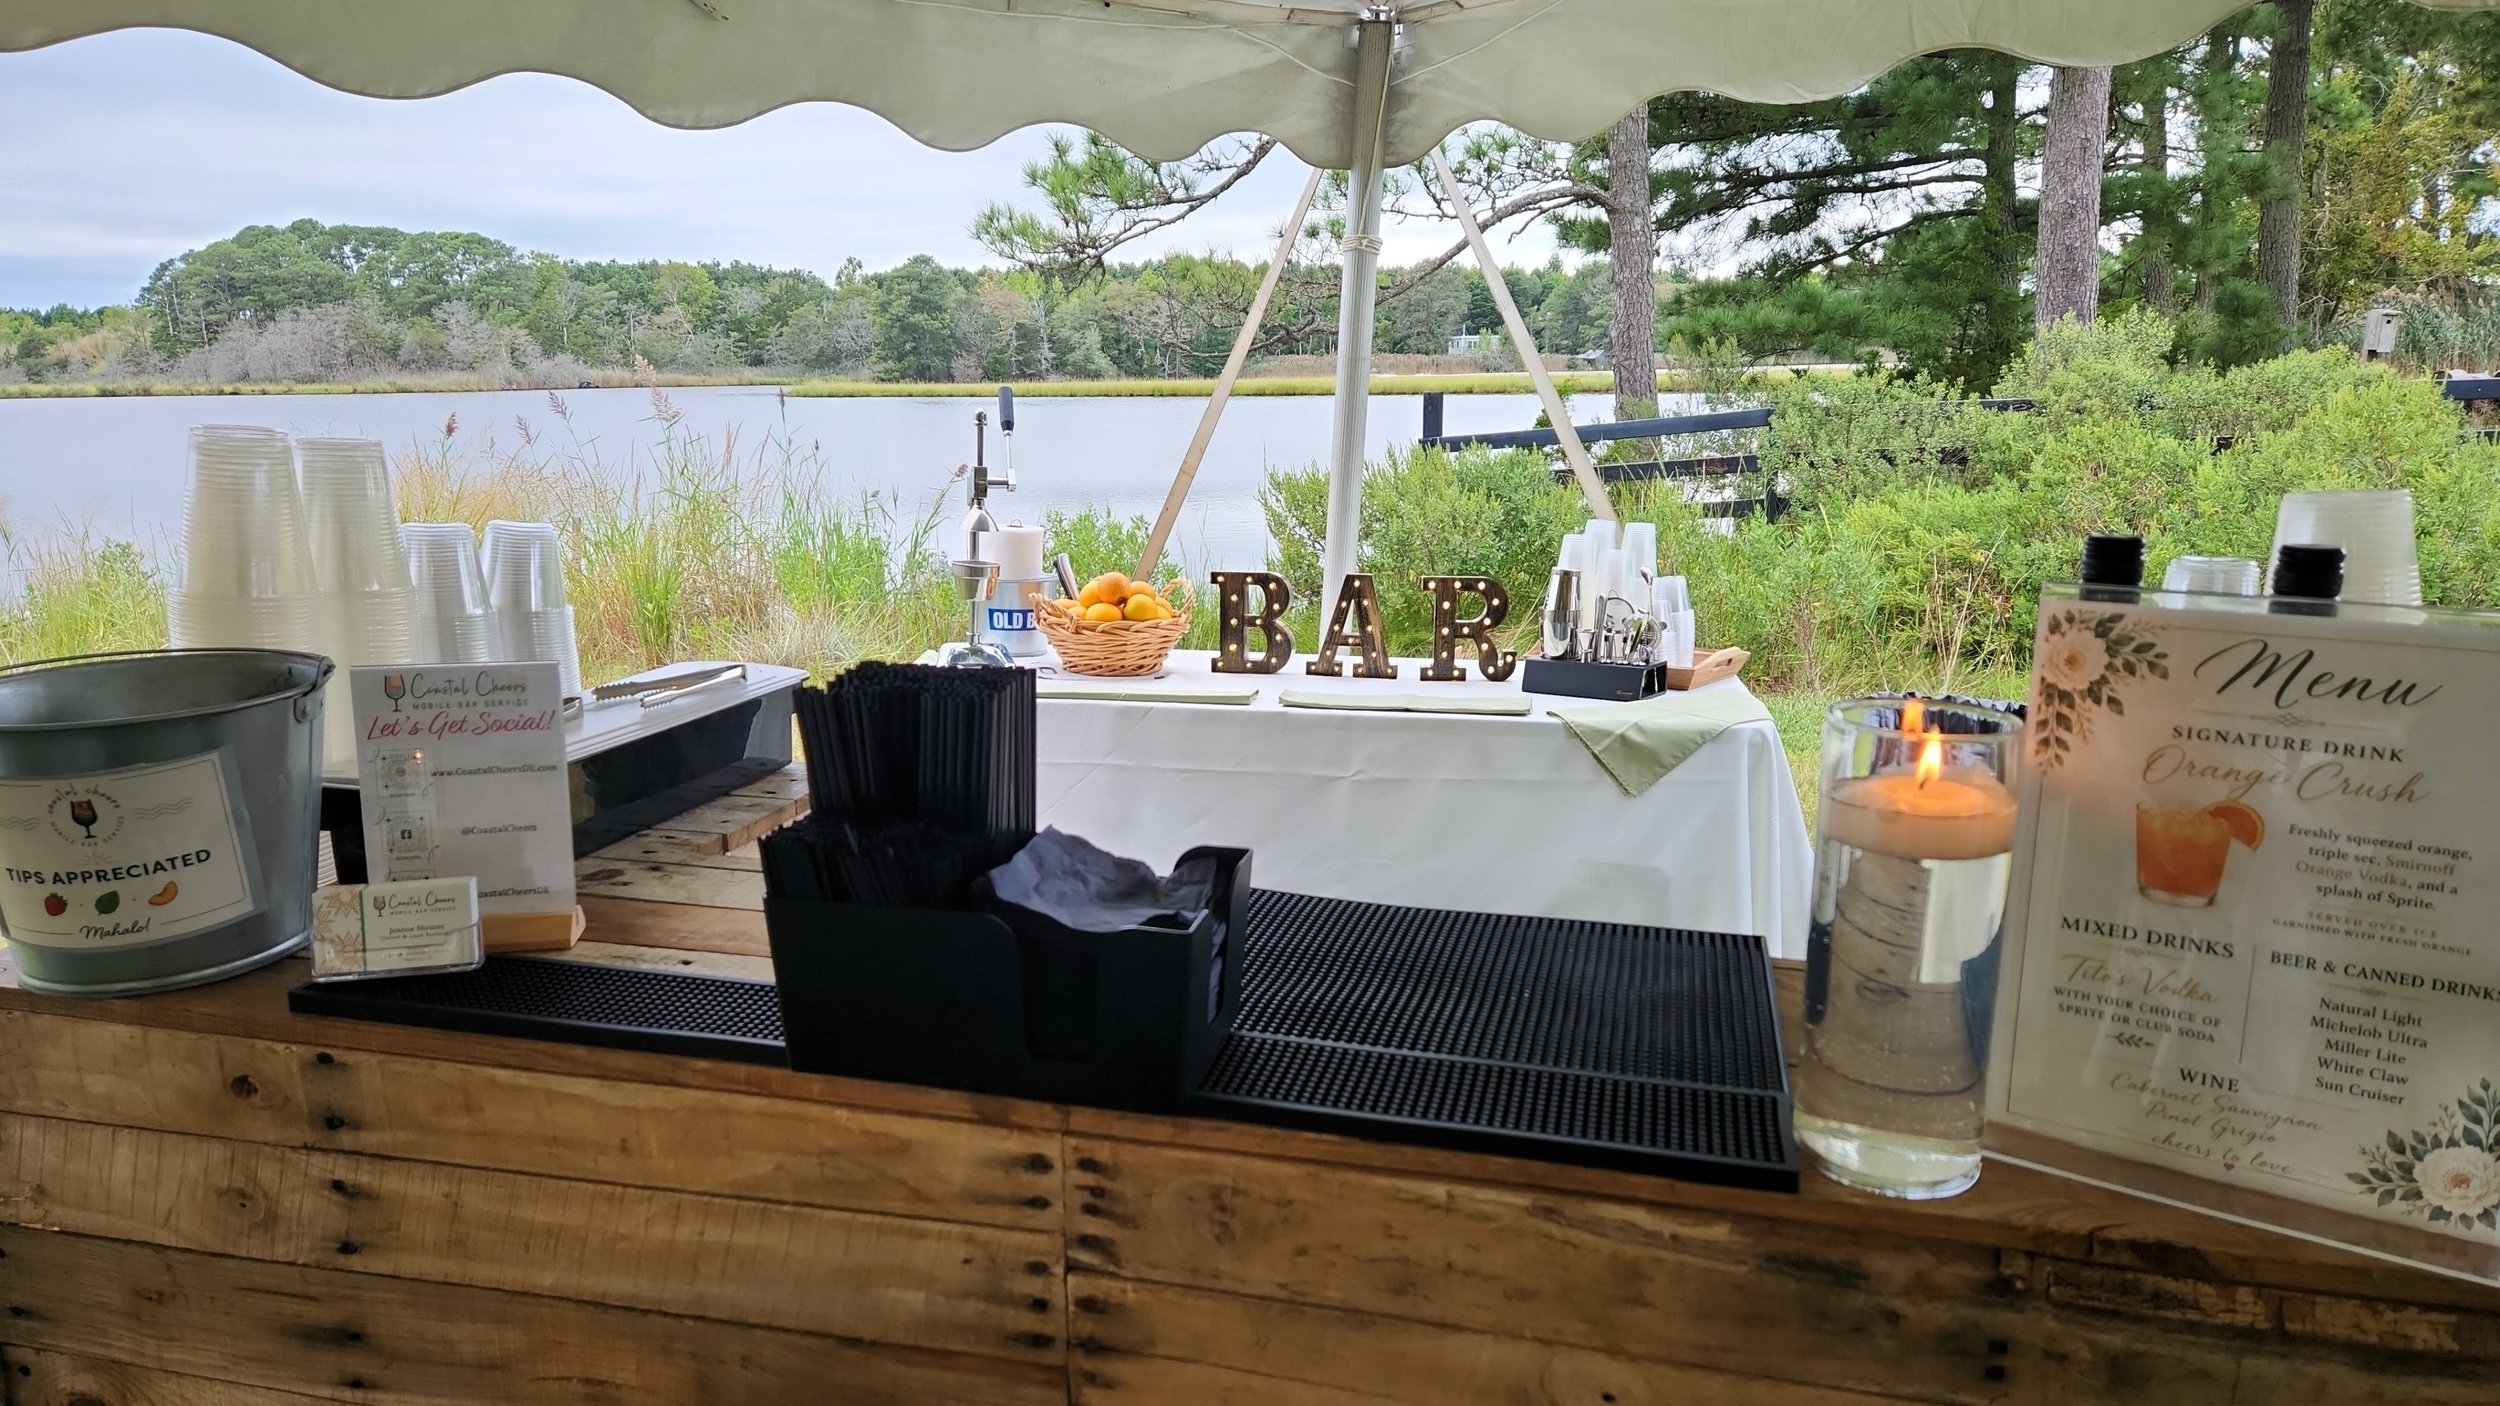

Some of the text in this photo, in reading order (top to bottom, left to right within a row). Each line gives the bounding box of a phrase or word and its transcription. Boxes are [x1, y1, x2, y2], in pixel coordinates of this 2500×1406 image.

[993, 612, 1022, 629] OLD
[1211, 571, 1516, 681] BAR
[411, 671, 528, 699] Coastal Cheers
[2193, 638, 2443, 709] Menu
[412, 703, 451, 711] MOBILE
[484, 699, 529, 708] SERVICE
[367, 709, 557, 741] Let's Get Social!
[2172, 725, 2404, 763] SIGNATURE DRINK
[2142, 744, 2431, 804] Orange Crush
[2289, 823, 2473, 862] Freshly squeezed orange,
[2308, 845, 2457, 876] triple sec, Smirnoff
[6, 849, 211, 885] TIPS APPRECIATED
[2295, 859, 2459, 895] Orange Vodka, and a
[478, 885, 550, 899] oastalCheersDE
[2316, 882, 2437, 910] splash of Sprite.
[79, 916, 151, 940] Mahalo!
[2060, 916, 2235, 959] MIXED DRINKS
[2272, 917, 2473, 956] GARNISHED WITH FRESH ORANGE
[2308, 911, 2439, 939] SERVED OVER ICE
[2062, 953, 2221, 1004] Tito's Vodka
[2270, 950, 2317, 971] BEER
[2323, 959, 2337, 974] &
[2343, 962, 2425, 989] CANNED
[2053, 985, 2222, 1028] WITH YOUR CHOICE OF
[2058, 1002, 2215, 1043] SPRITE OR CLUB SODA
[2319, 996, 2423, 1028] Natural Light
[2310, 1014, 2428, 1049] Michelob Ultra
[2324, 1037, 2407, 1065] Miller Lite
[2179, 1067, 2240, 1093] WINE
[2317, 1055, 2409, 1086] White Claw
[2110, 1072, 2323, 1131] Cabernet Sauvignon
[2315, 1076, 2405, 1106] Sun Cruiser
[2146, 1101, 2277, 1146] Pinot Grigio
[2151, 1131, 2295, 1174] cheers to love
